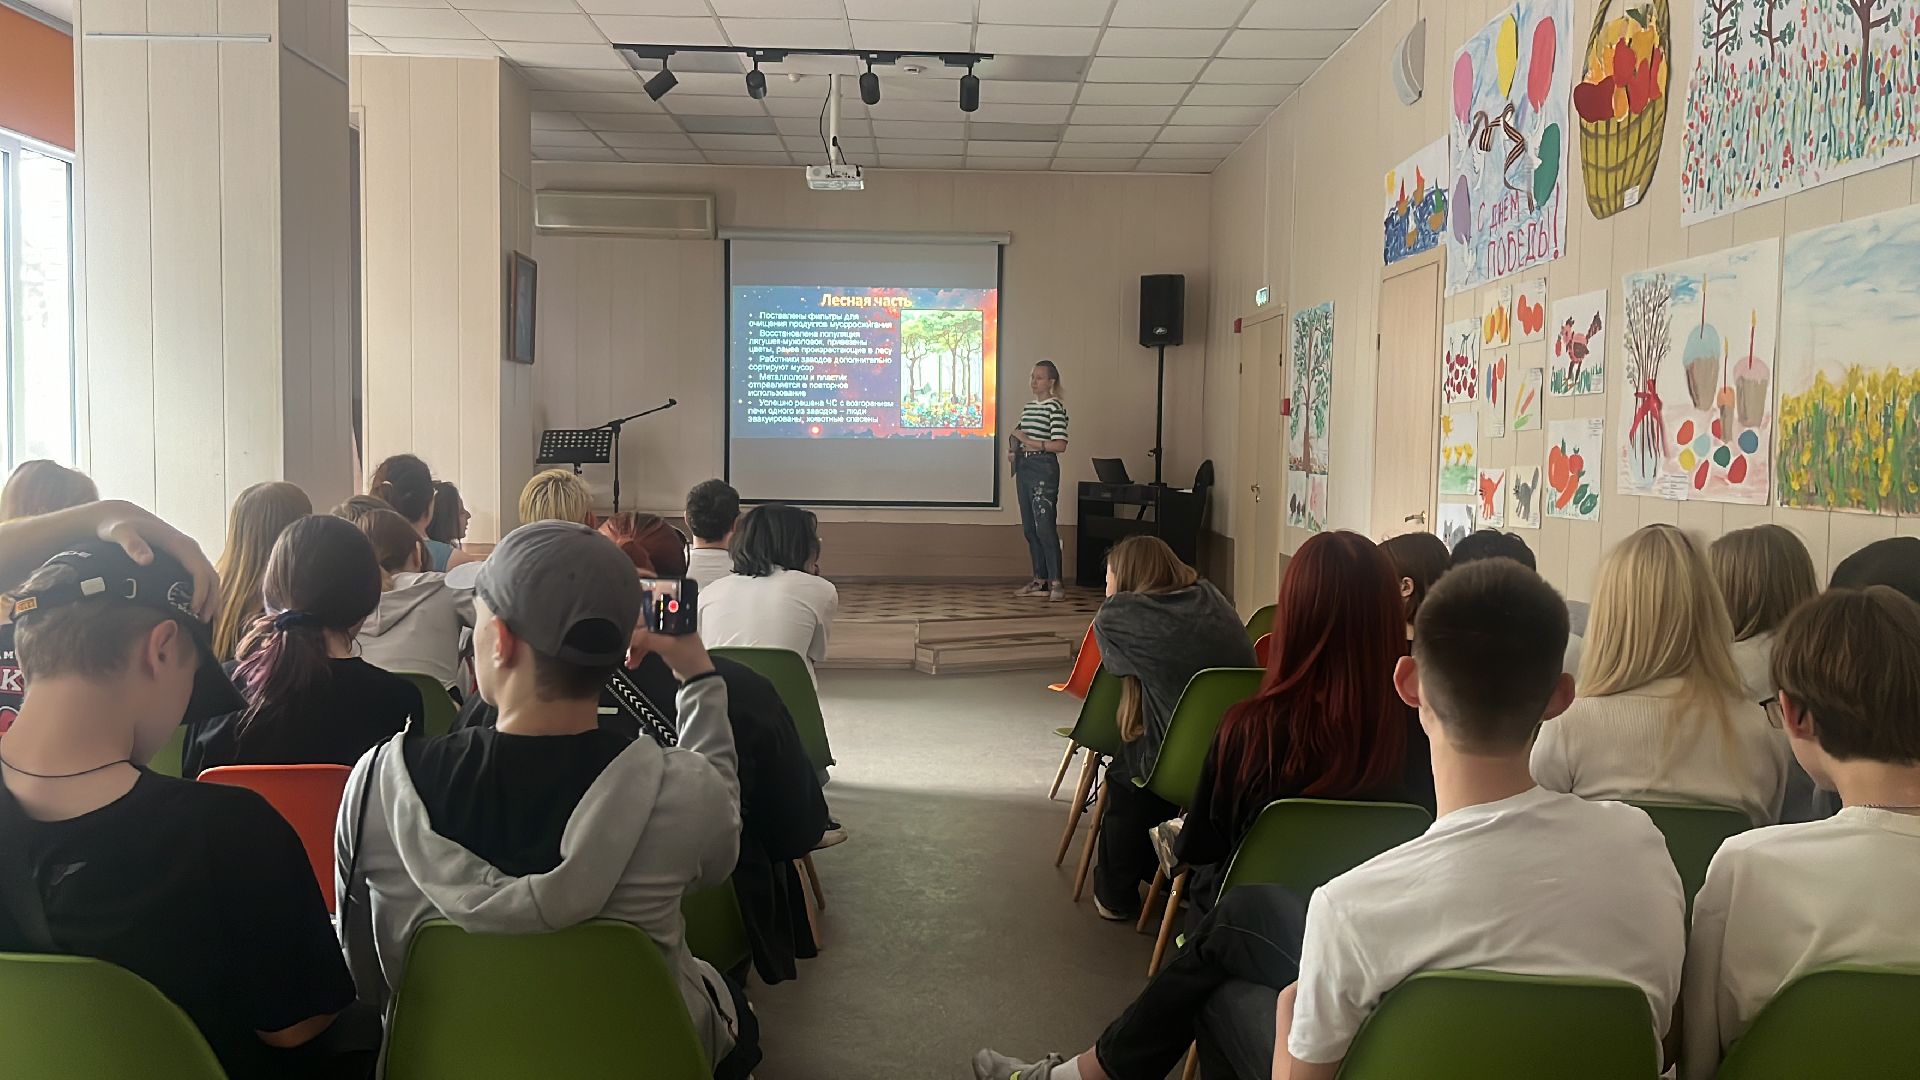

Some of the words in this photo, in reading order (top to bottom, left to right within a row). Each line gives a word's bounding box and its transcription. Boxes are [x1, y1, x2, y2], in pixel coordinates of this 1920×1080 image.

[1477, 201, 1486, 232] С
[1487, 182, 1559, 280] ПОБЕДЫ!
[820, 293, 871, 308] Лесная
[874, 296, 912, 308] часть
[759, 312, 806, 320] Поставлены
[808, 312, 842, 321] фильтры
[789, 321, 828, 329] продуктов
[760, 329, 818, 337] Восстановлена
[875, 347, 892, 355] лесу
[759, 355, 799, 363] Работники
[748, 364, 788, 372] сортируют
[791, 364, 814, 372] мусор
[759, 373, 808, 381] Металлолом
[759, 399, 792, 407] Успешно
